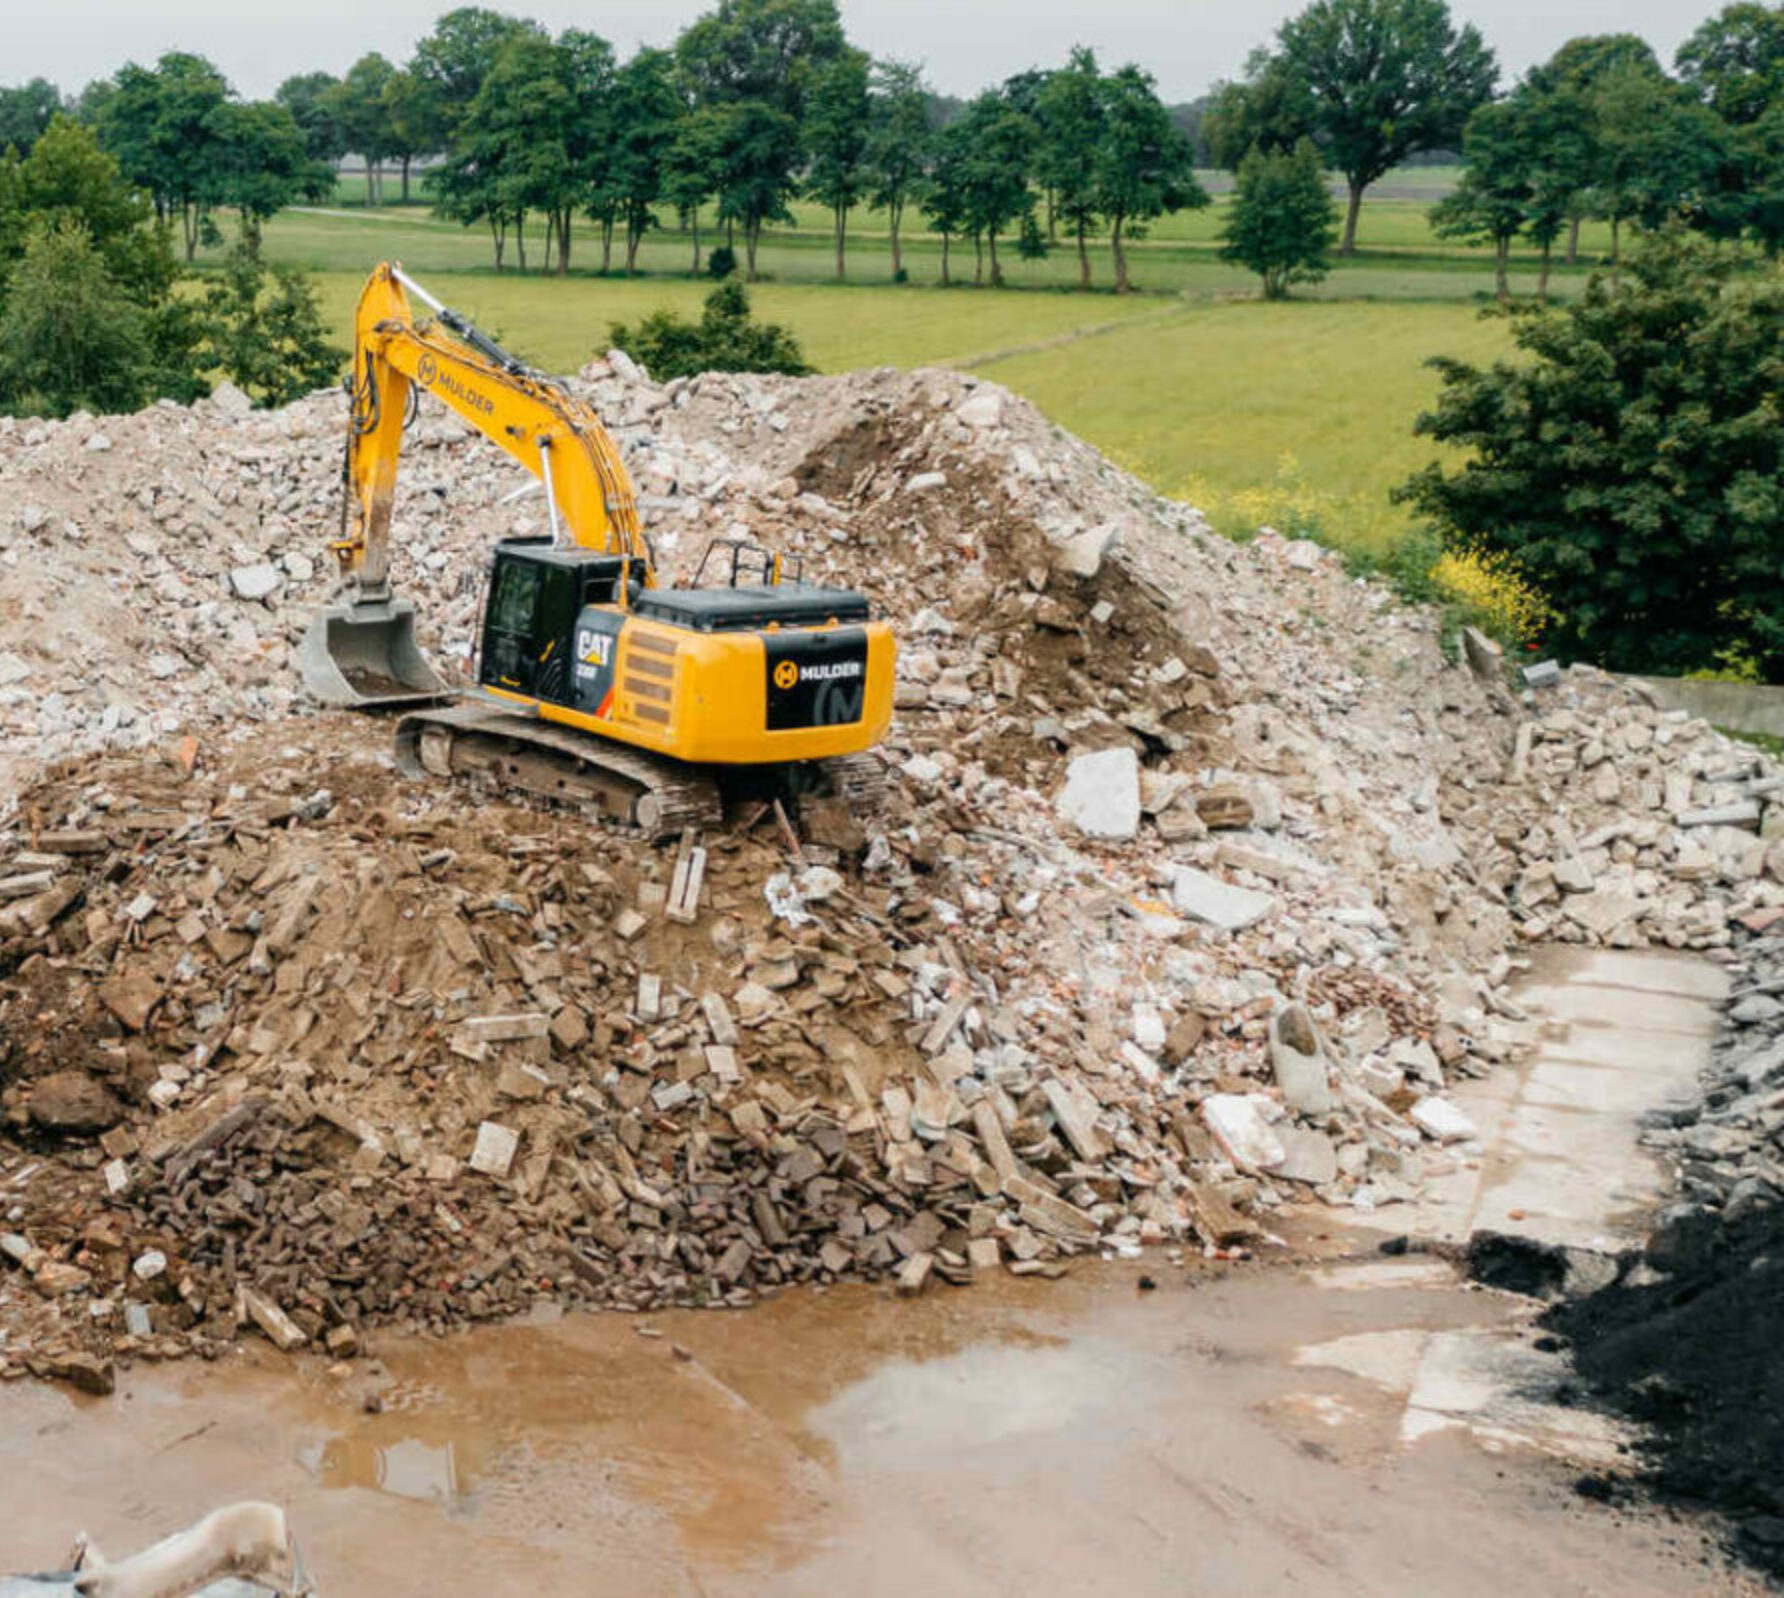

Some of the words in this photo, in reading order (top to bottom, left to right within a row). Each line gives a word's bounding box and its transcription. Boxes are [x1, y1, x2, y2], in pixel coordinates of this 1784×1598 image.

[439, 370, 494, 416] MULDER
[578, 630, 613, 666] CAT
[800, 661, 860, 680] MULDER
